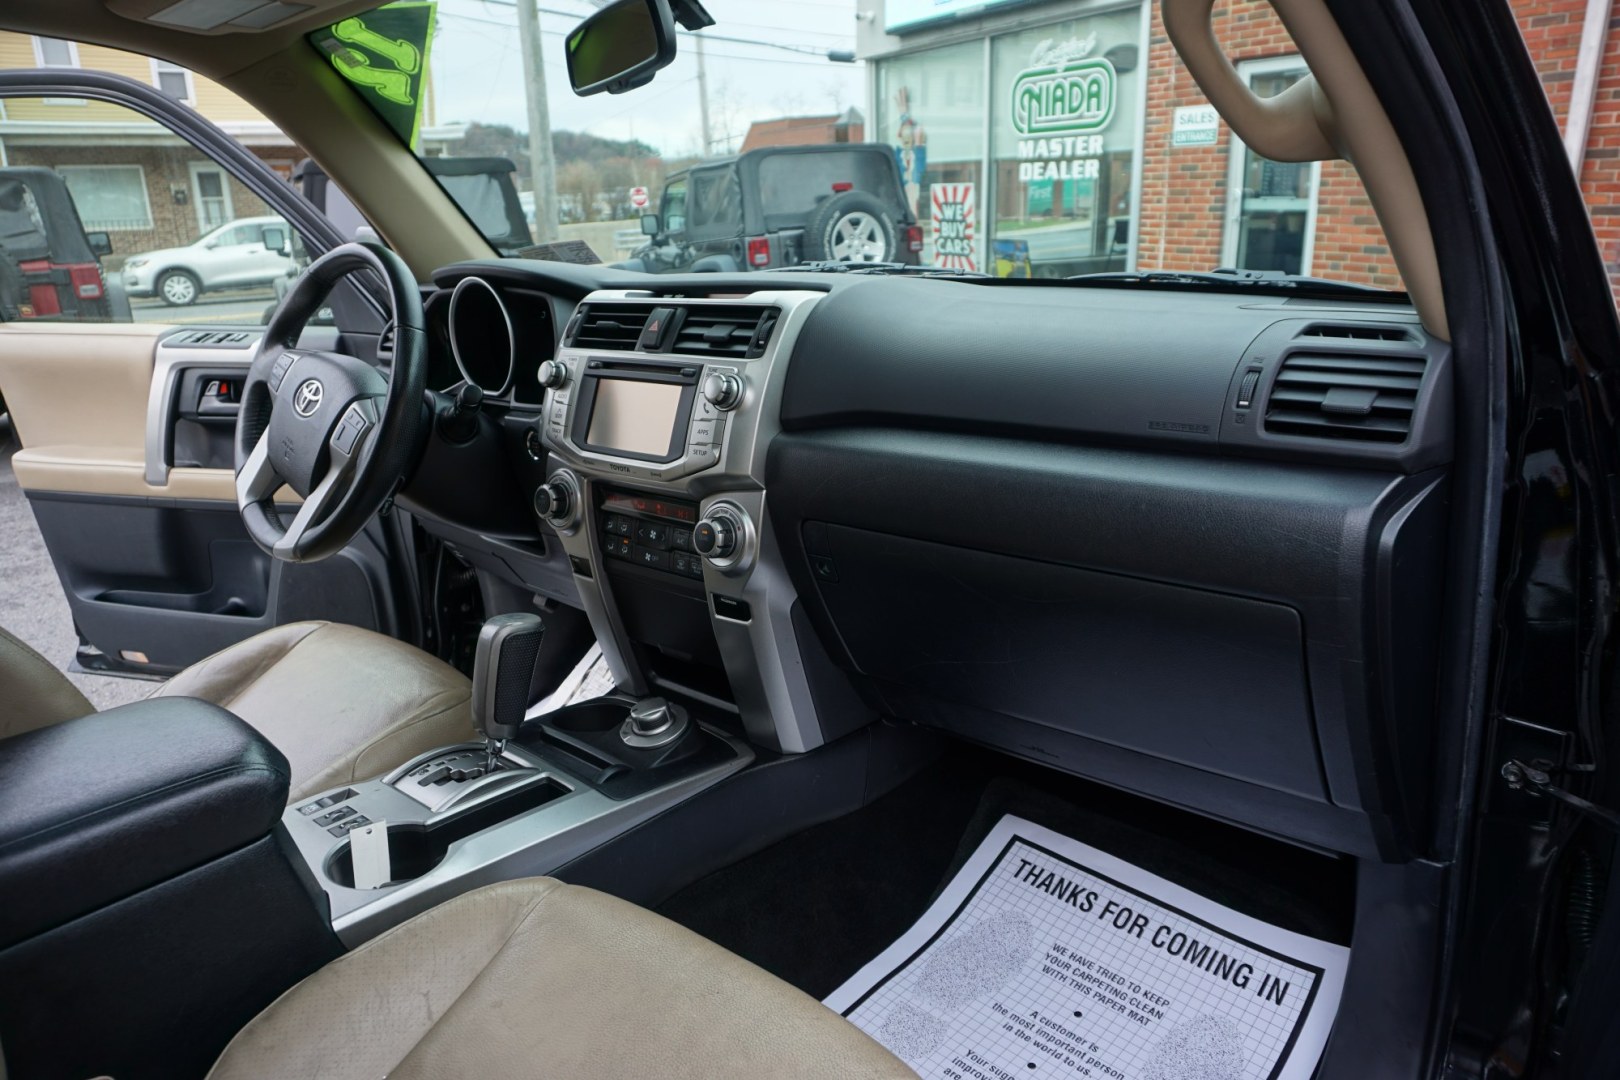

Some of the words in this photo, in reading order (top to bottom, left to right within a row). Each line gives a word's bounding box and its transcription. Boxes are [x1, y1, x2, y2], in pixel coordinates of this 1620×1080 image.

[1019, 74, 1103, 120] NIADA
[1179, 112, 1215, 125] SALES
[1018, 134, 1104, 160] MASTER
[1018, 159, 1101, 181] DEALER
[941, 203, 965, 221] WE
[940, 221, 967, 238] BUY
[935, 237, 971, 256] CARS
[692, 449, 708, 457] SETUP
[609, 463, 631, 473] TOYOTA
[1013, 858, 1099, 913] THANKS
[1098, 899, 1150, 939] FOR
[1151, 925, 1254, 990] COMING
[1257, 973, 1290, 1006] IN
[1045, 952, 1072, 972] YOUR
[1072, 967, 1128, 1001] CARPETING
[1129, 997, 1165, 1020] CLEAN
[1052, 943, 1069, 957] WE
[1069, 951, 1096, 970] HAVE
[1096, 965, 1126, 986] TRIED
[1127, 981, 1142, 994] TO
[1142, 989, 1170, 1008] KEEP
[1041, 964, 1068, 983] WITH
[1068, 978, 1092, 996] THIS
[1093, 991, 1127, 1014] PAPER
[1127, 1009, 1152, 1026] MAT
[991, 1002, 1009, 1016] the
[1009, 1013, 1035, 1031] most
[1035, 1027, 1087, 1060] important
[1085, 1056, 1126, 1080] person
[1029, 1010, 1039, 1020] A
[1039, 1016, 1088, 1046] customer
[1088, 1042, 1099, 1053] is
[965, 1049, 989, 1068] Your
[1002, 1022, 1014, 1032] in
[1014, 1028, 1032, 1042] the
[1033, 1039, 1064, 1060] world
[1063, 1056, 1076, 1067] to
[1076, 1064, 1092, 1078] us.
